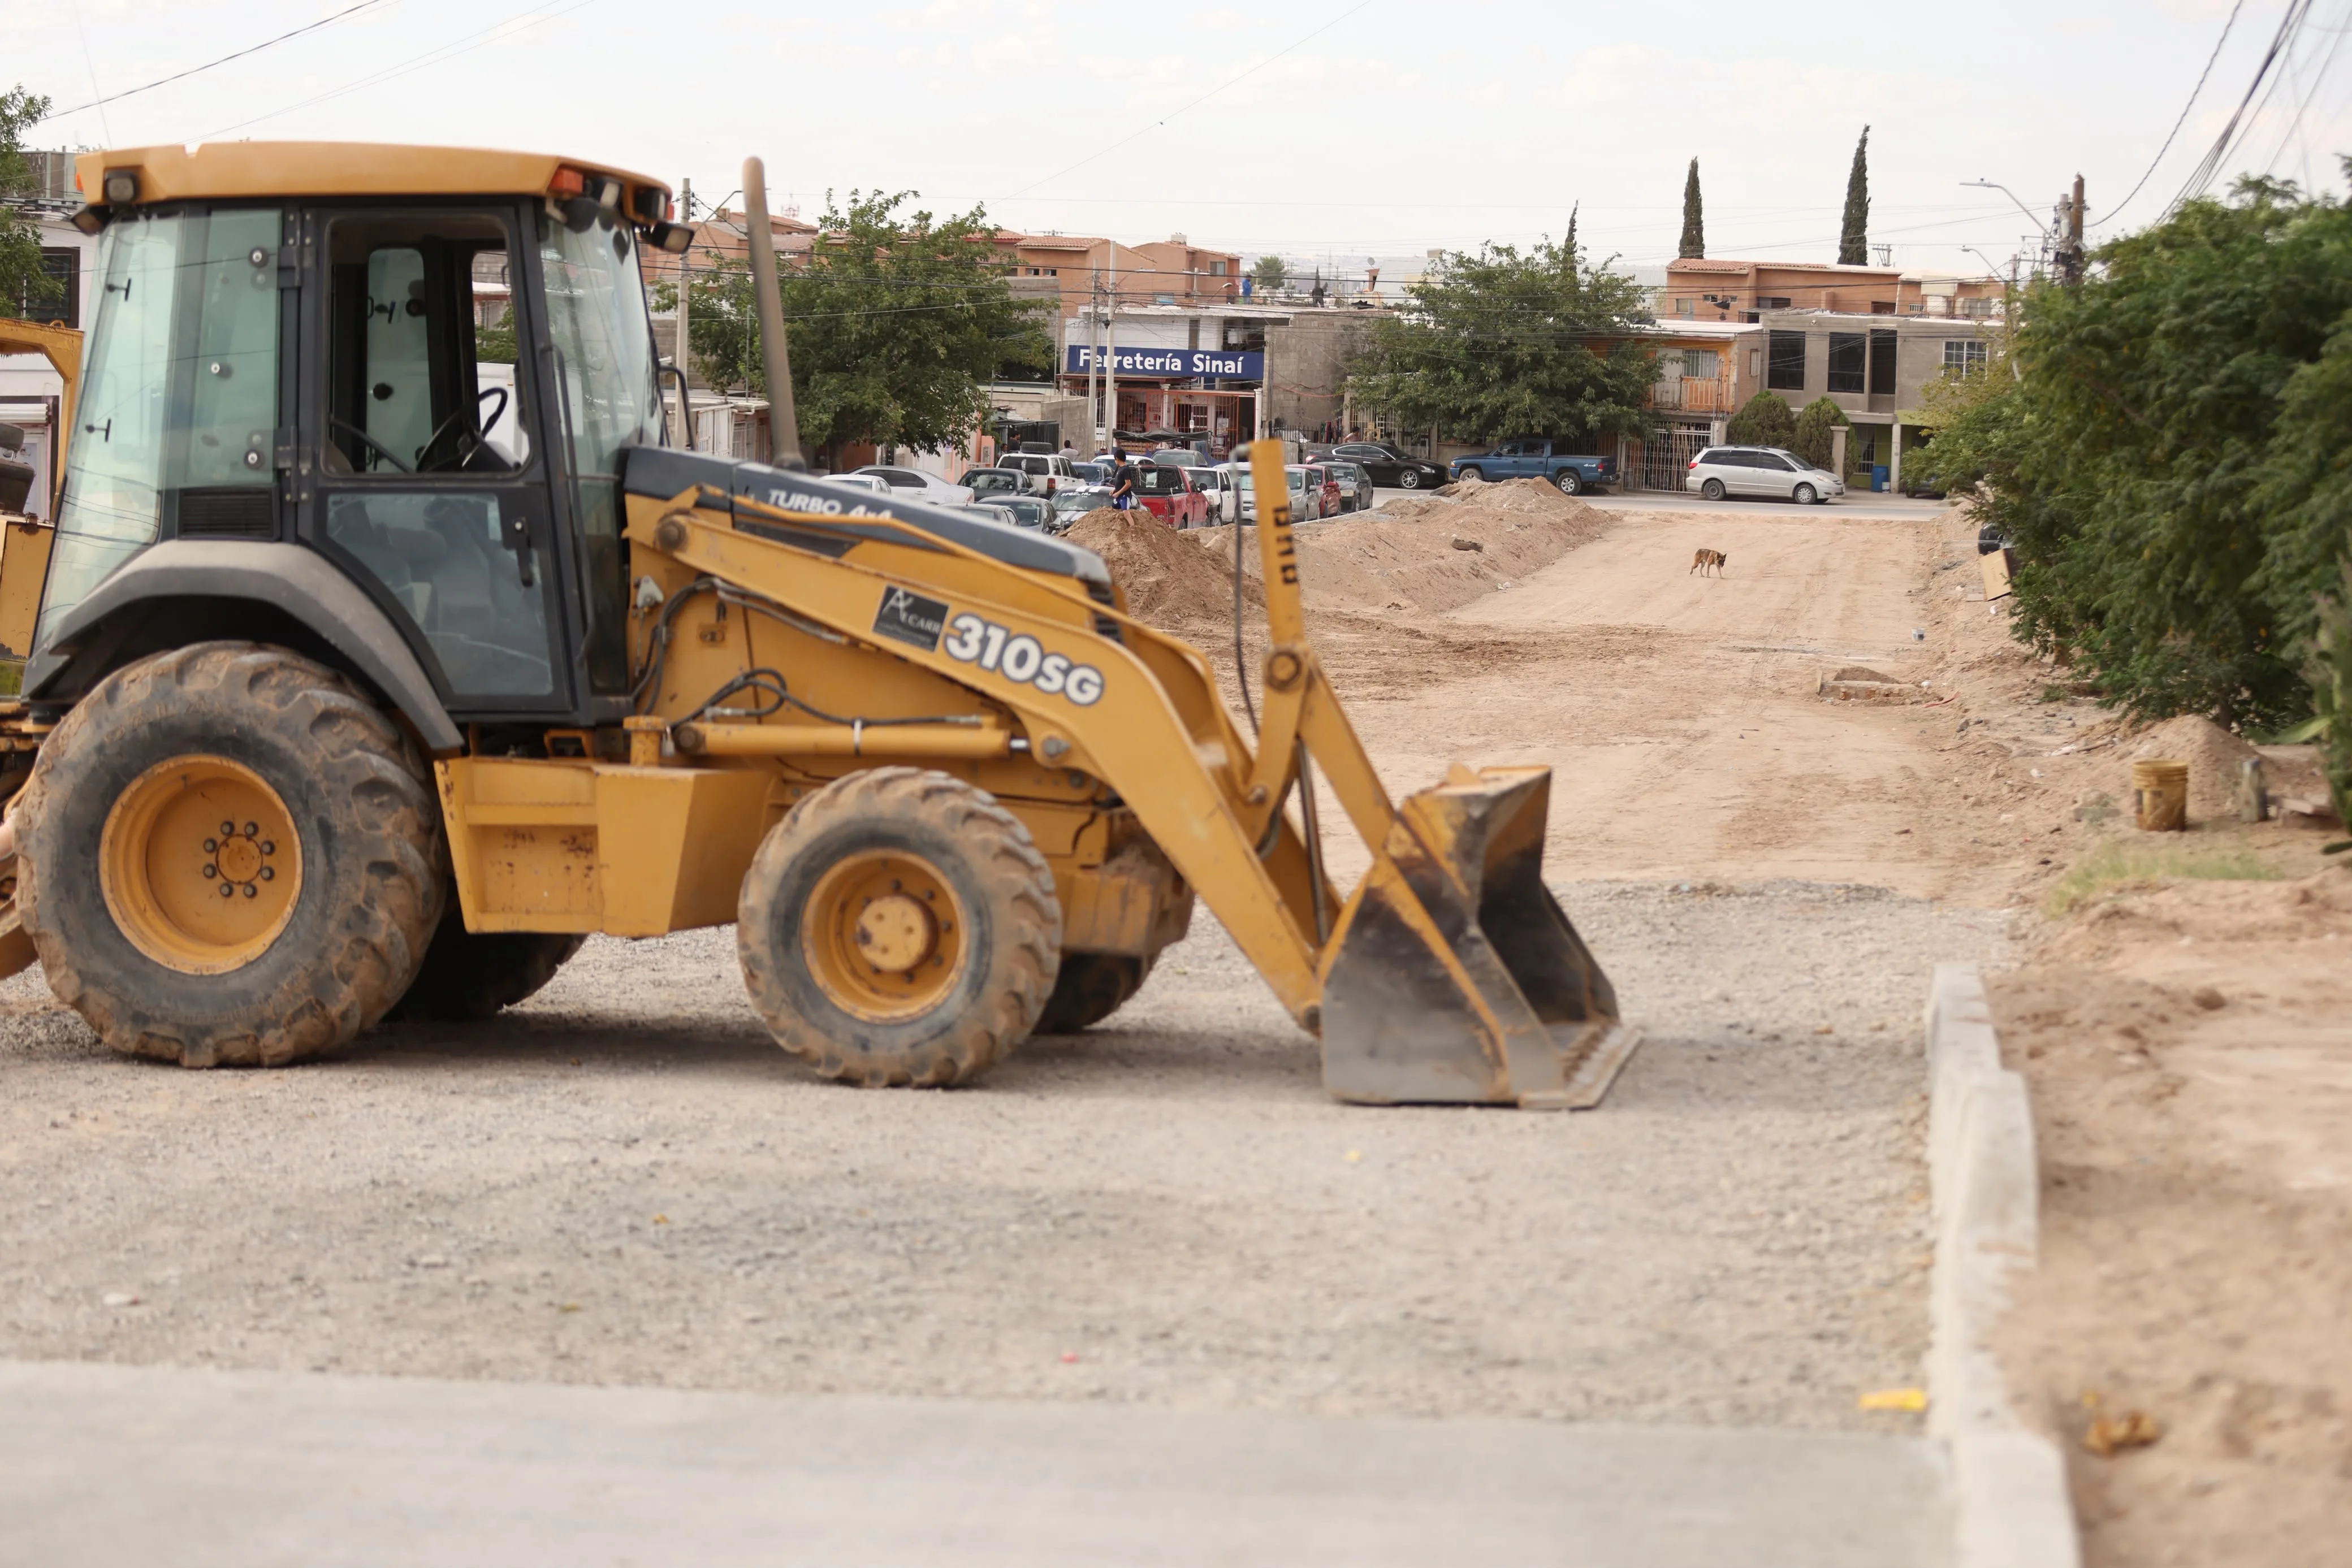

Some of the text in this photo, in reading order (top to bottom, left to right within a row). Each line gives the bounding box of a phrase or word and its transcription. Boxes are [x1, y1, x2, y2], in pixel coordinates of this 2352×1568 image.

[1079, 349, 1244, 374] Ferretería Sinaí
[768, 490, 842, 516] TURBO
[945, 613, 1104, 705] 310SG
